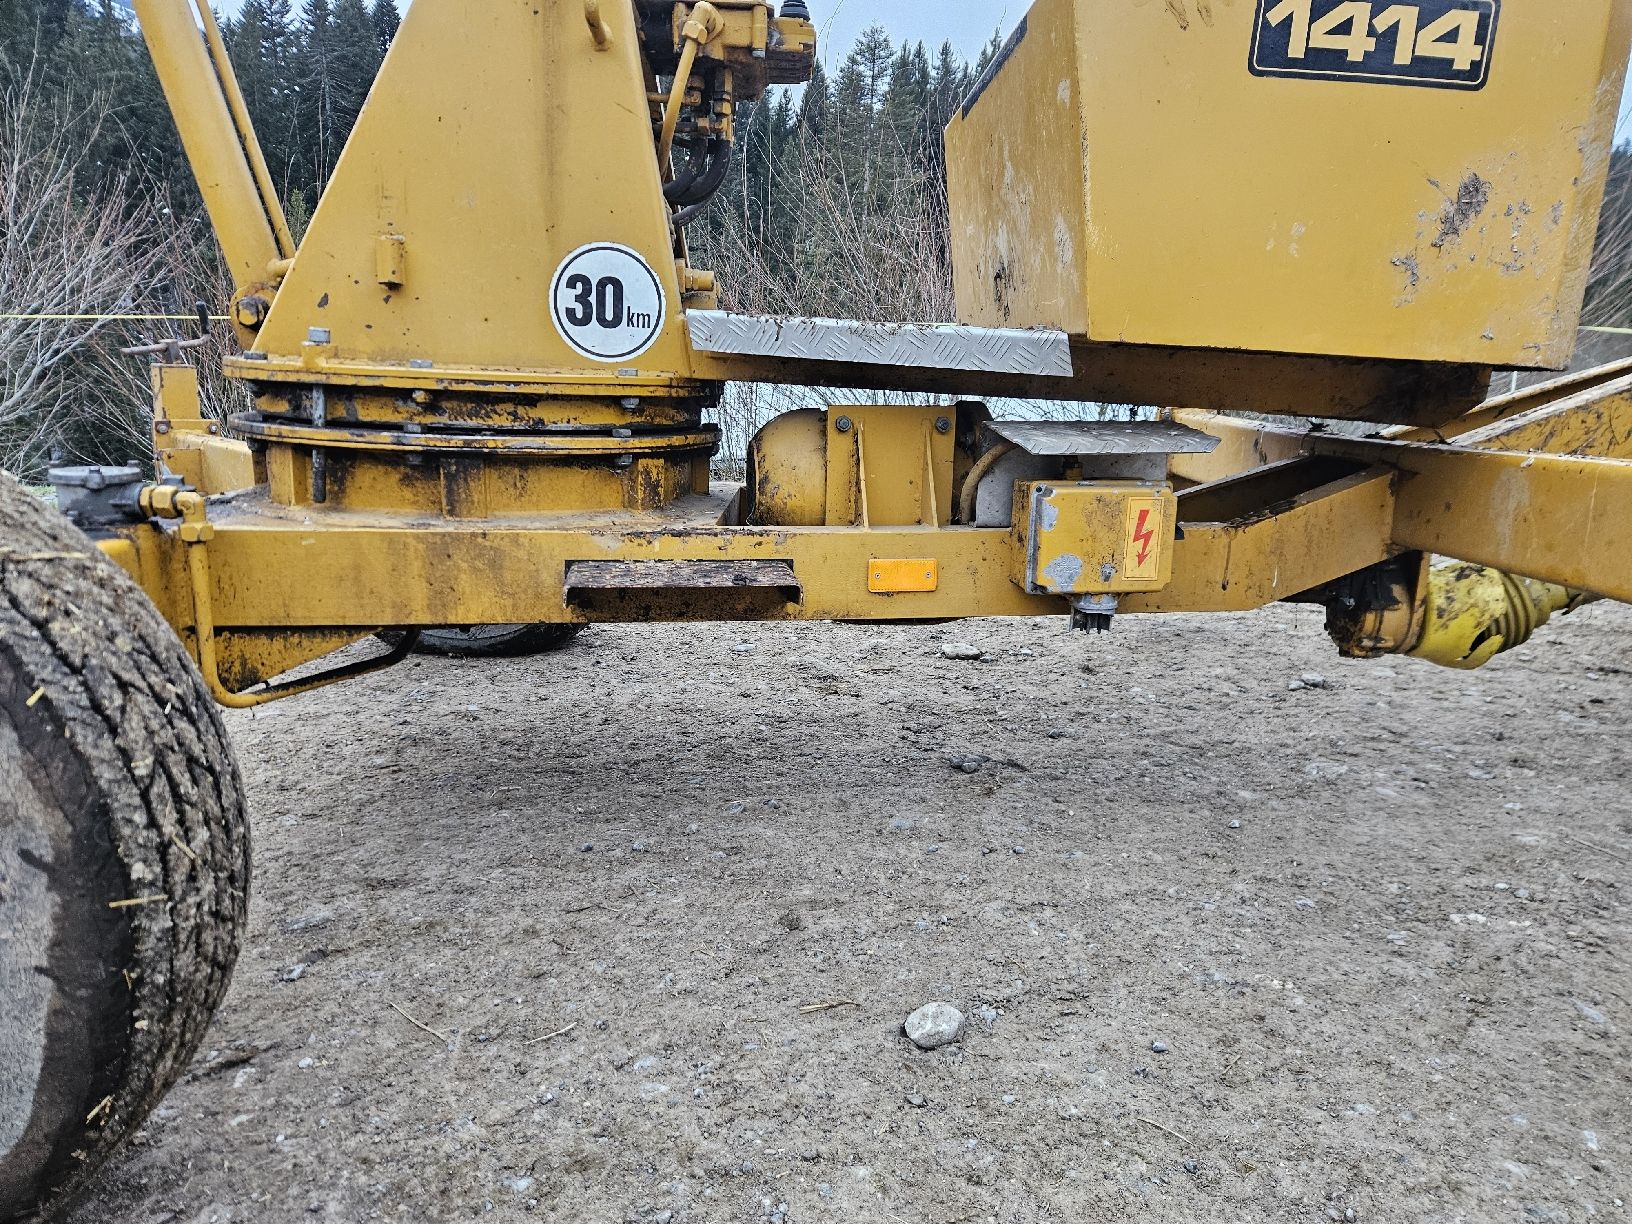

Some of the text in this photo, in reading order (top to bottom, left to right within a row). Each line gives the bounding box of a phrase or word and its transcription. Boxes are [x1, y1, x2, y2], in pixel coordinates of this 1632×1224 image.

[1265, 0, 1483, 70] 1414
[565, 273, 651, 329] 30 km
